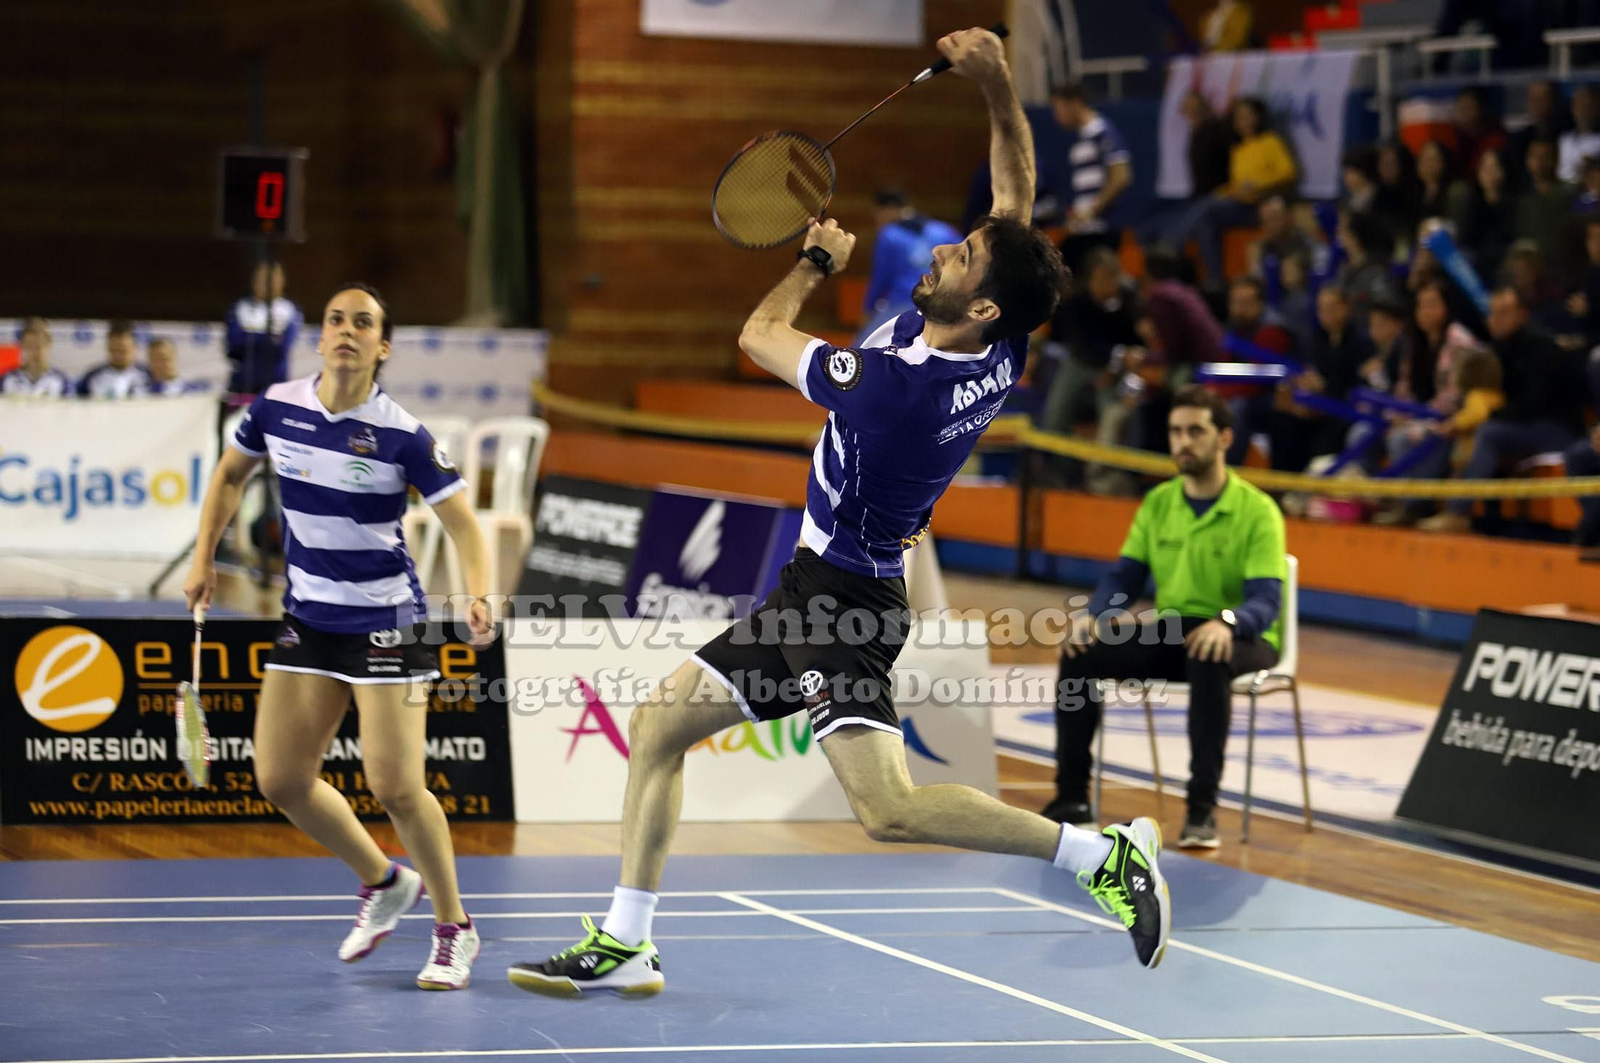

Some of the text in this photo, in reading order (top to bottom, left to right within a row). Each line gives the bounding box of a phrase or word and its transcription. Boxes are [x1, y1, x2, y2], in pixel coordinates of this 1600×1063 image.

[257, 172, 285, 219] 0
[0, 453, 202, 522] Cajasol
[26, 729, 168, 761] IMPRESIÓN
[1442, 708, 1511, 755] bebida
[1502, 729, 1556, 767] para
[225, 771, 253, 791] 52
[463, 795, 491, 814] 21
